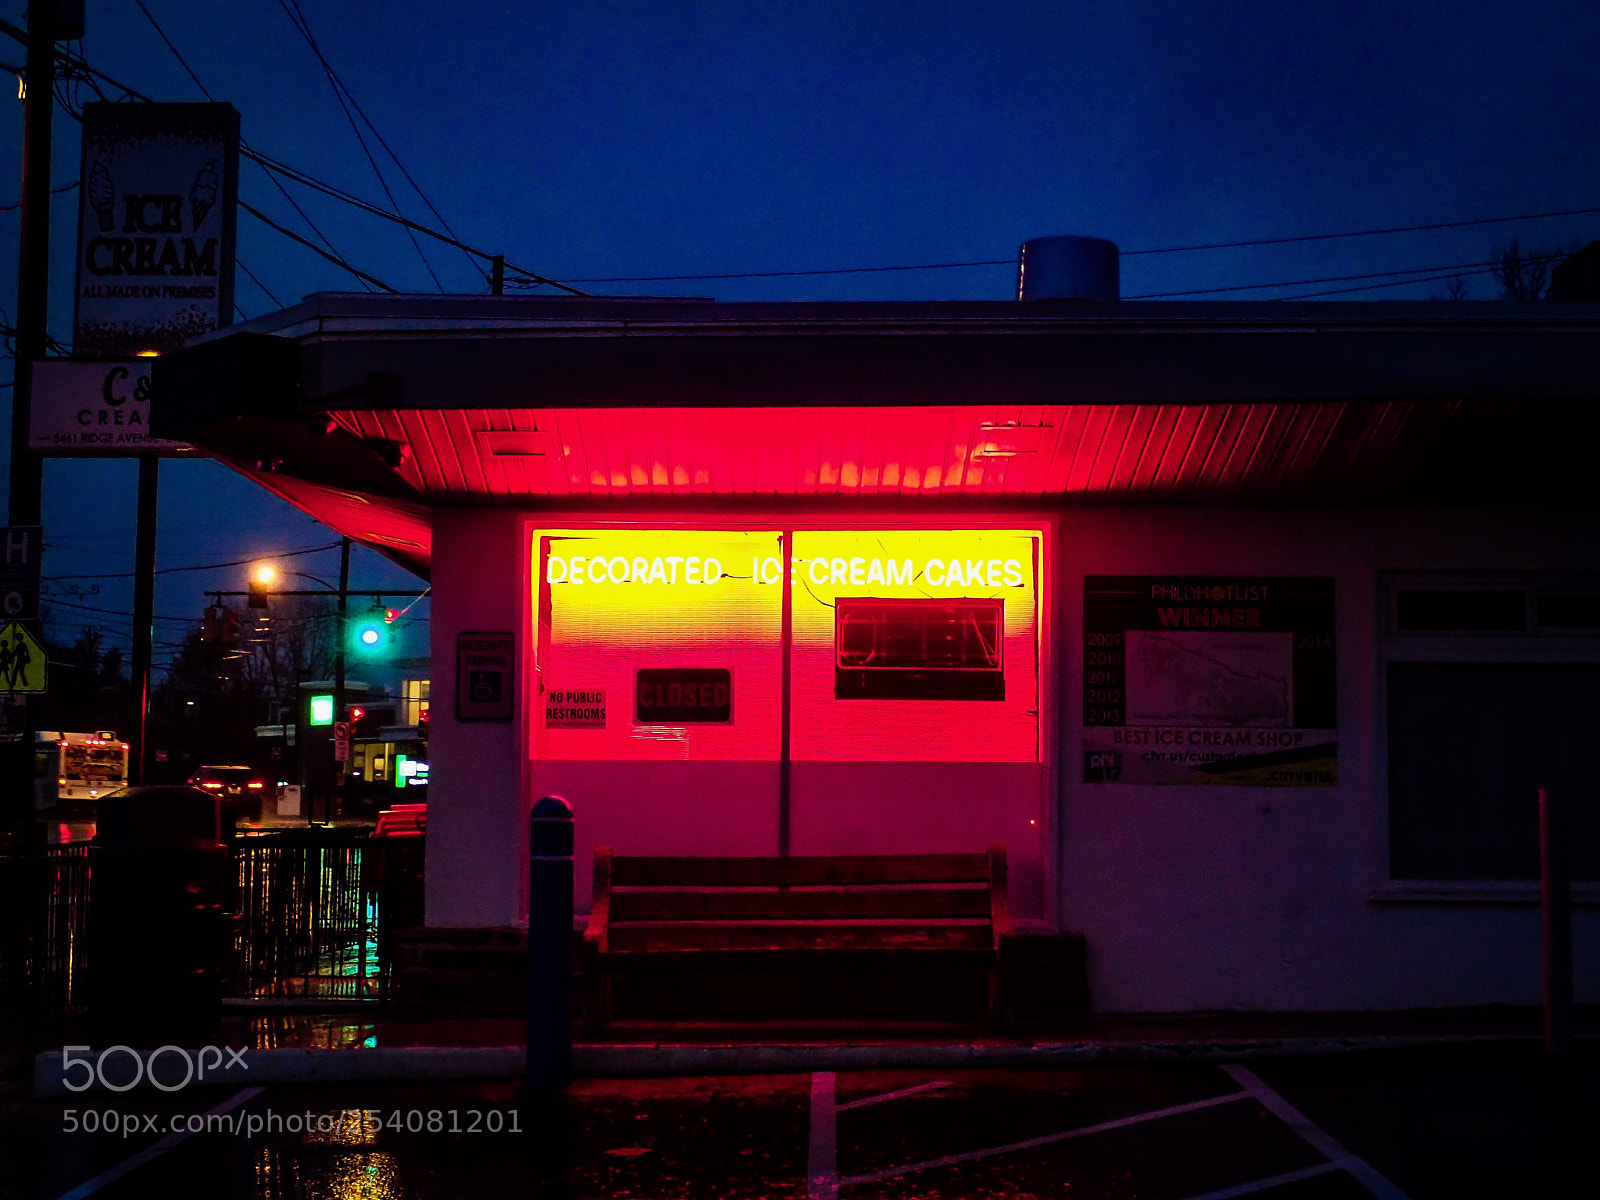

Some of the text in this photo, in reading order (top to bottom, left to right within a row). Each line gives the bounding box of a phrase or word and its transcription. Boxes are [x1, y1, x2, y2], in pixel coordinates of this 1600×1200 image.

[122, 195, 183, 232] ICE
[85, 237, 217, 275] CREAM
[83, 287, 216, 298] ALL MADE ON PREMISES
[103, 366, 129, 406] C
[77, 409, 151, 425] CREA
[54, 433, 77, 444] 5461
[81, 433, 114, 444] RIDGE
[6, 531, 27, 565] H
[546, 555, 722, 585] DECORATED
[808, 557, 912, 586] CREAM
[924, 557, 1023, 588] CAKES
[1157, 607, 1264, 629] WINNER
[1087, 633, 1122, 648] 2009
[1297, 635, 1331, 649] 2014
[1087, 652, 1122, 666] 2010
[1087, 671, 1117, 685] 2011
[550, 692, 602, 704] NO PUBLIC
[639, 683, 728, 709] CLOSED
[1087, 690, 1121, 704] 2012
[546, 708, 606, 720] RESTROOMS
[1087, 709, 1121, 722] 2013
[1114, 731, 1304, 747] BEST ICE CREAM SHOP
